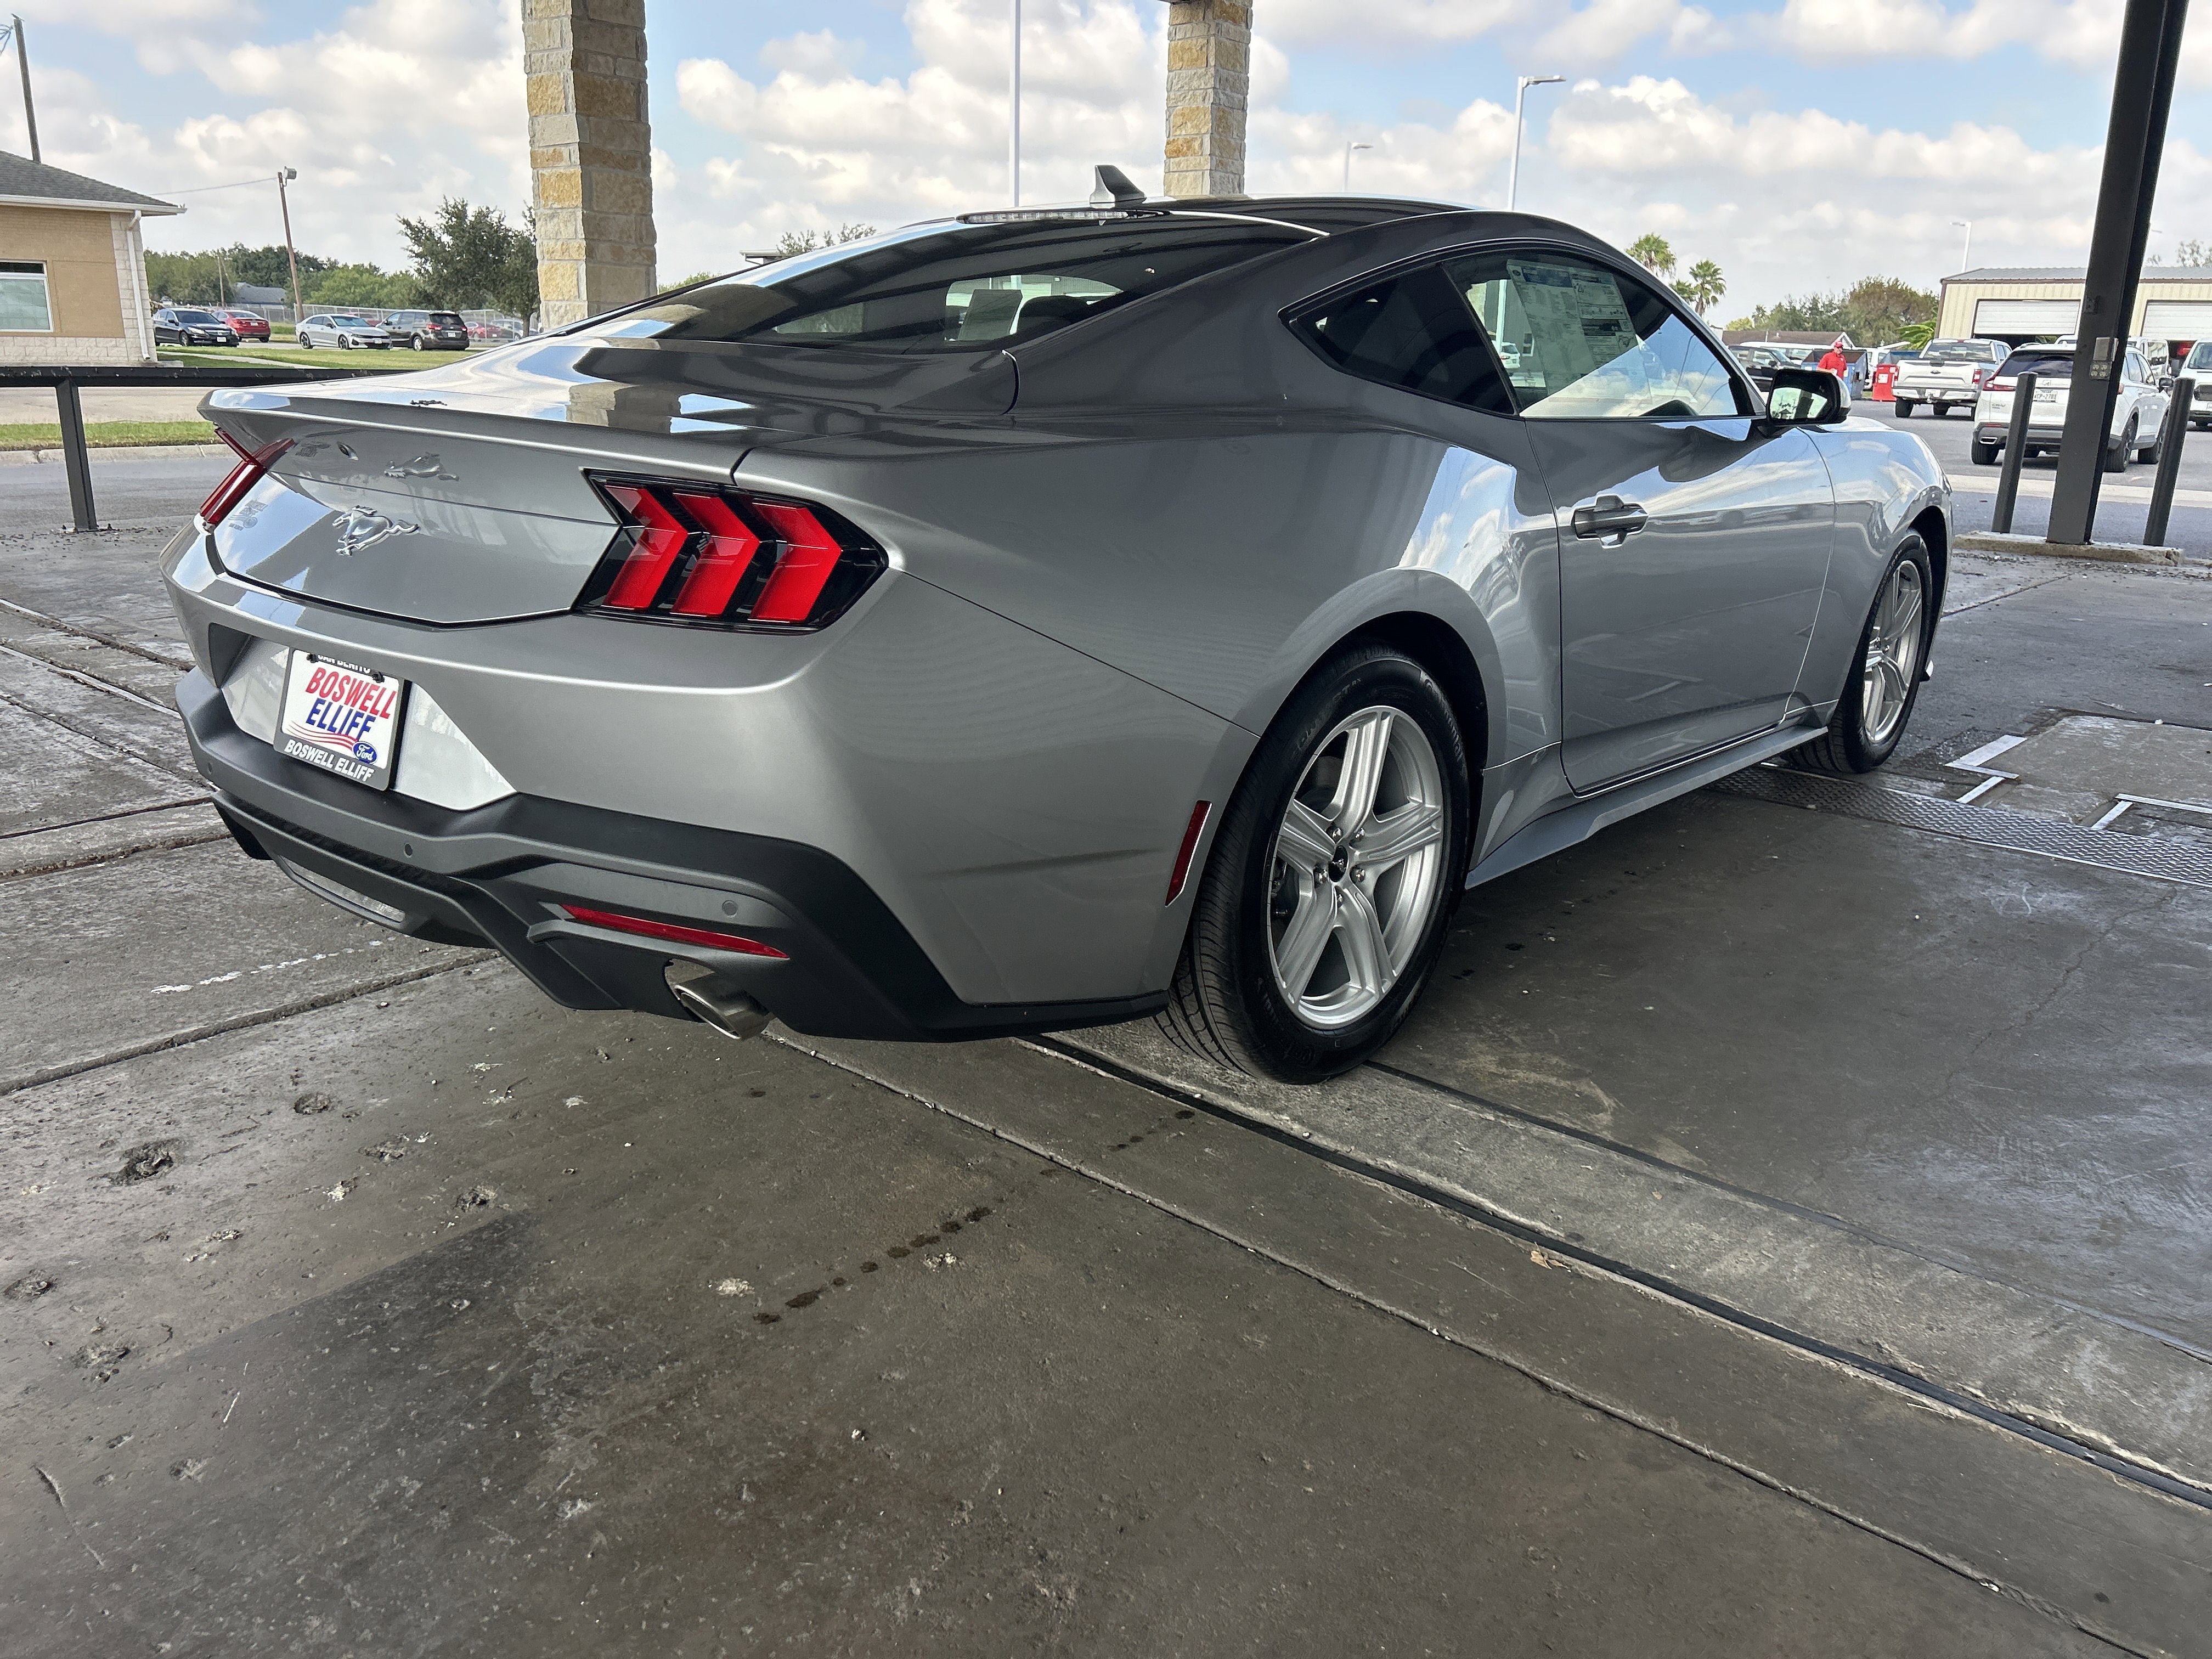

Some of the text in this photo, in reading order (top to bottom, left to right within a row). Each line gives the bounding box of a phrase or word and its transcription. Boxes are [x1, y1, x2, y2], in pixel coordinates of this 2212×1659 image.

[306, 667, 398, 719] BOSWELL
[306, 697, 376, 741] ELLIFF
[284, 739, 375, 782] BOSWELL ELLIFF
[357, 744, 374, 761] Ford
